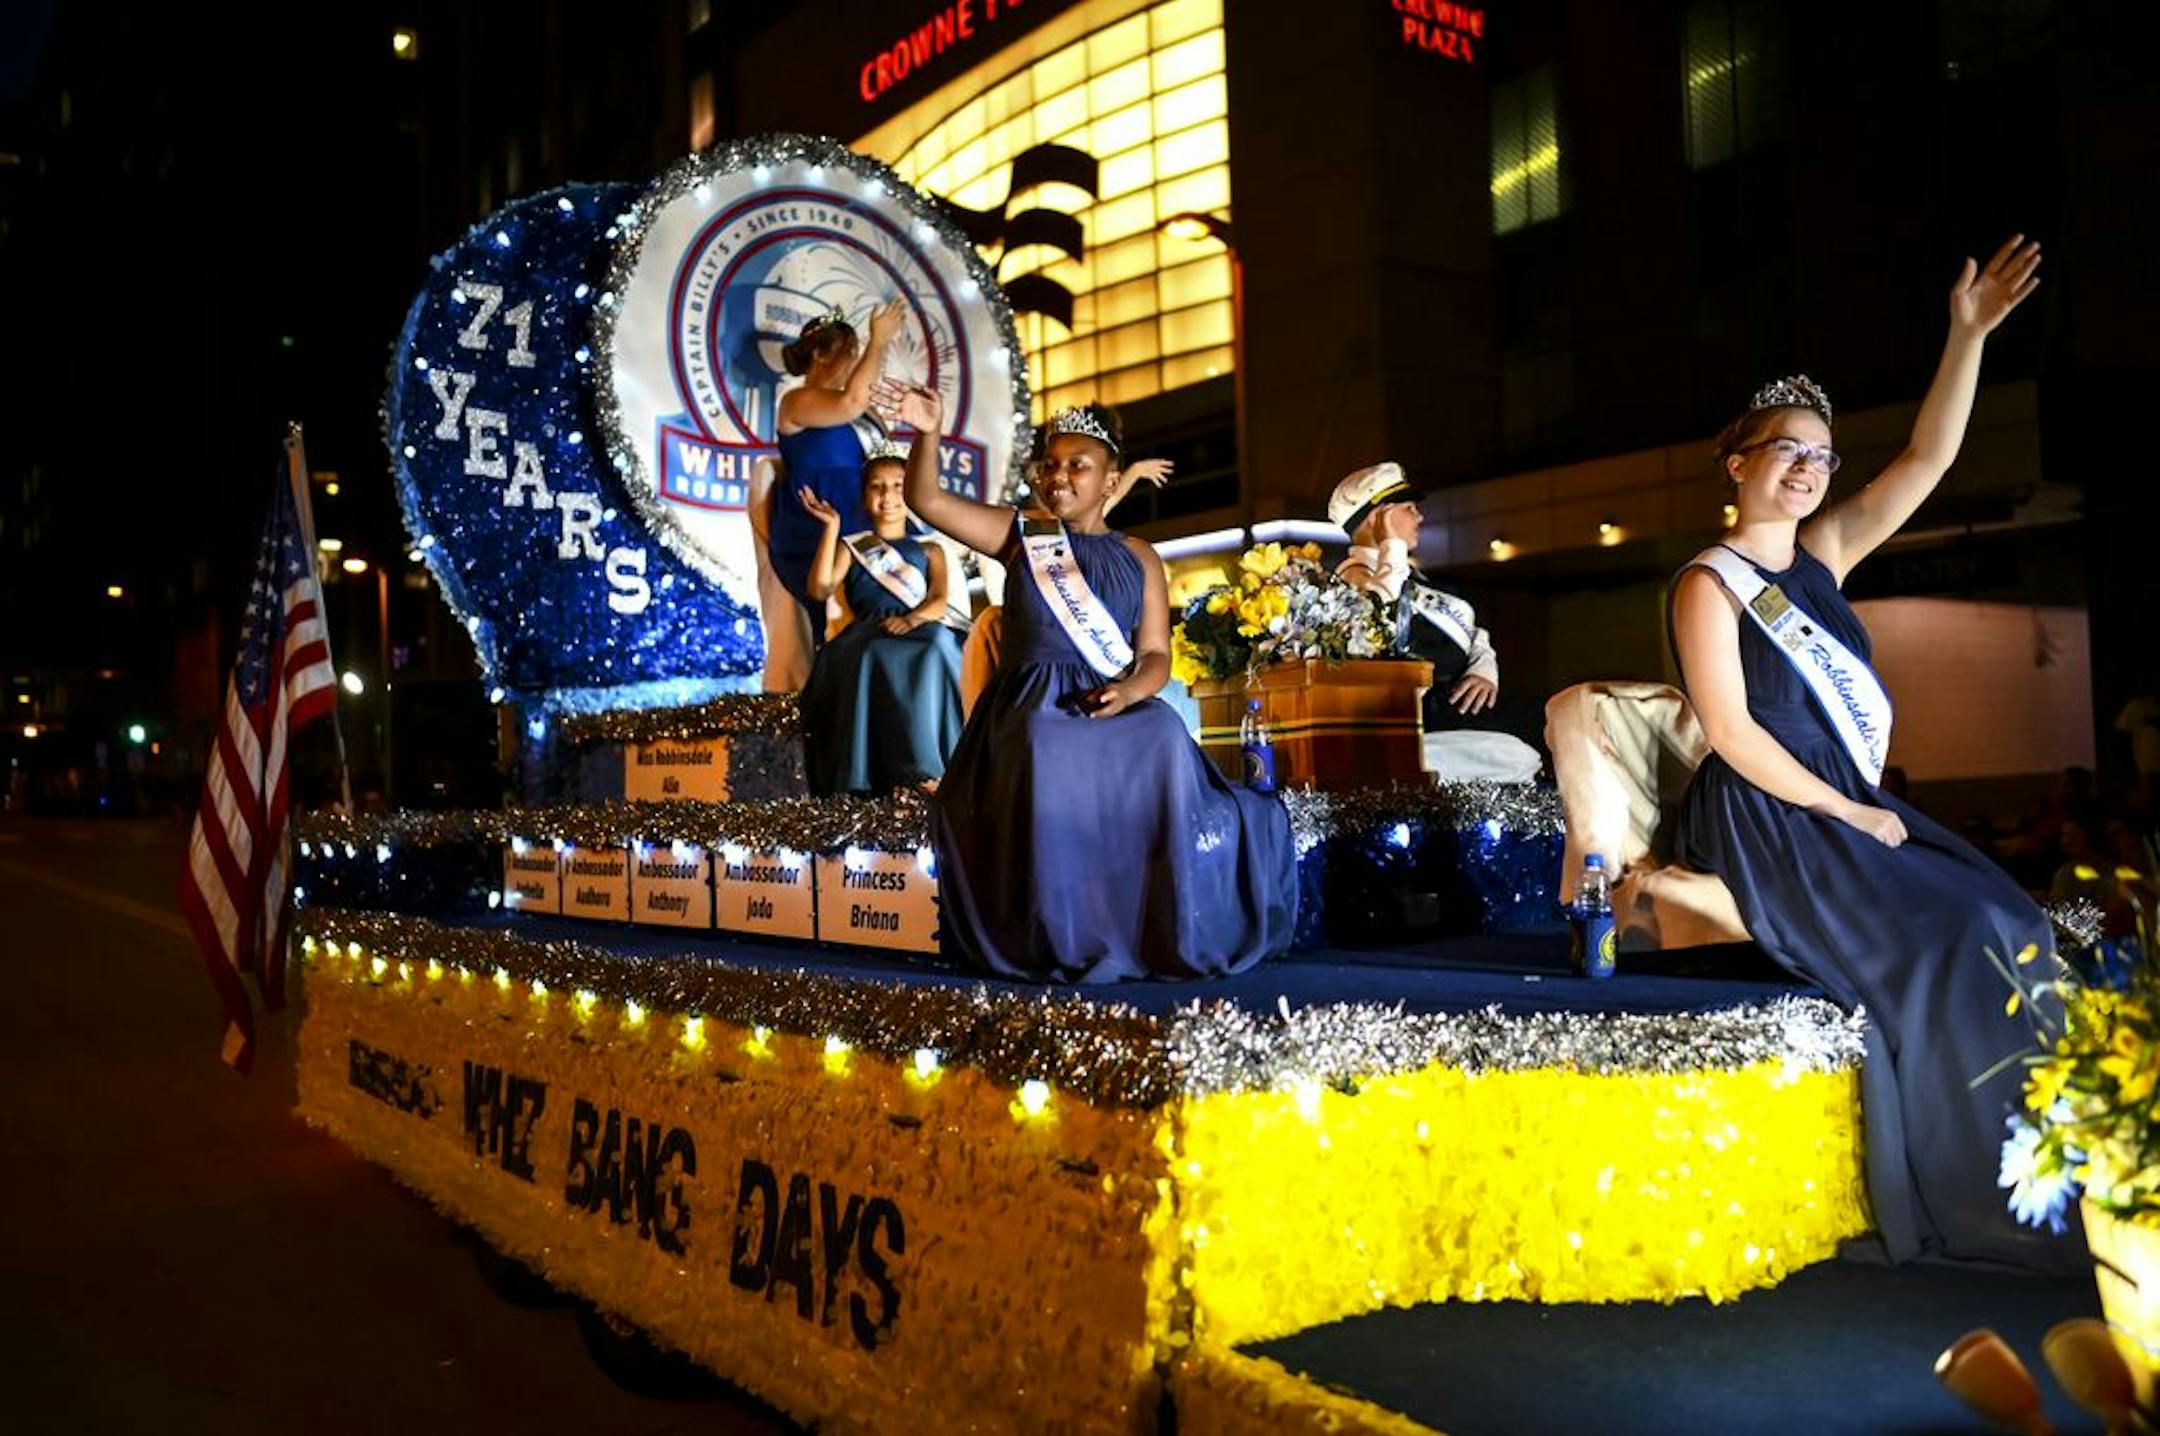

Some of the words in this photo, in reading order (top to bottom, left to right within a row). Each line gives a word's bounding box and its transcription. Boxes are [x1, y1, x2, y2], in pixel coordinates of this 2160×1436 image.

[860, 0, 975, 101] CROWNE
[1402, 16, 1474, 63] PLAZA
[747, 207, 800, 233] SINCE
[808, 208, 854, 230] 1940
[691, 241, 730, 313] BILLY'S
[456, 280, 538, 369] 71
[690, 323, 721, 418] CAPTAIN
[678, 442, 765, 480] WHI
[939, 446, 973, 476] YS
[428, 369, 651, 615] YEARS
[1806, 642, 1878, 743] Robbinsdale
[637, 860, 699, 879] Ambassador
[724, 862, 800, 885] Ambassador
[842, 865, 907, 892] Princess
[647, 890, 691, 918] Anthony
[746, 896, 773, 921] Jada
[850, 903, 900, 931] Briana
[565, 1098, 697, 1257] BANG
[729, 1158, 906, 1352] DAYS
